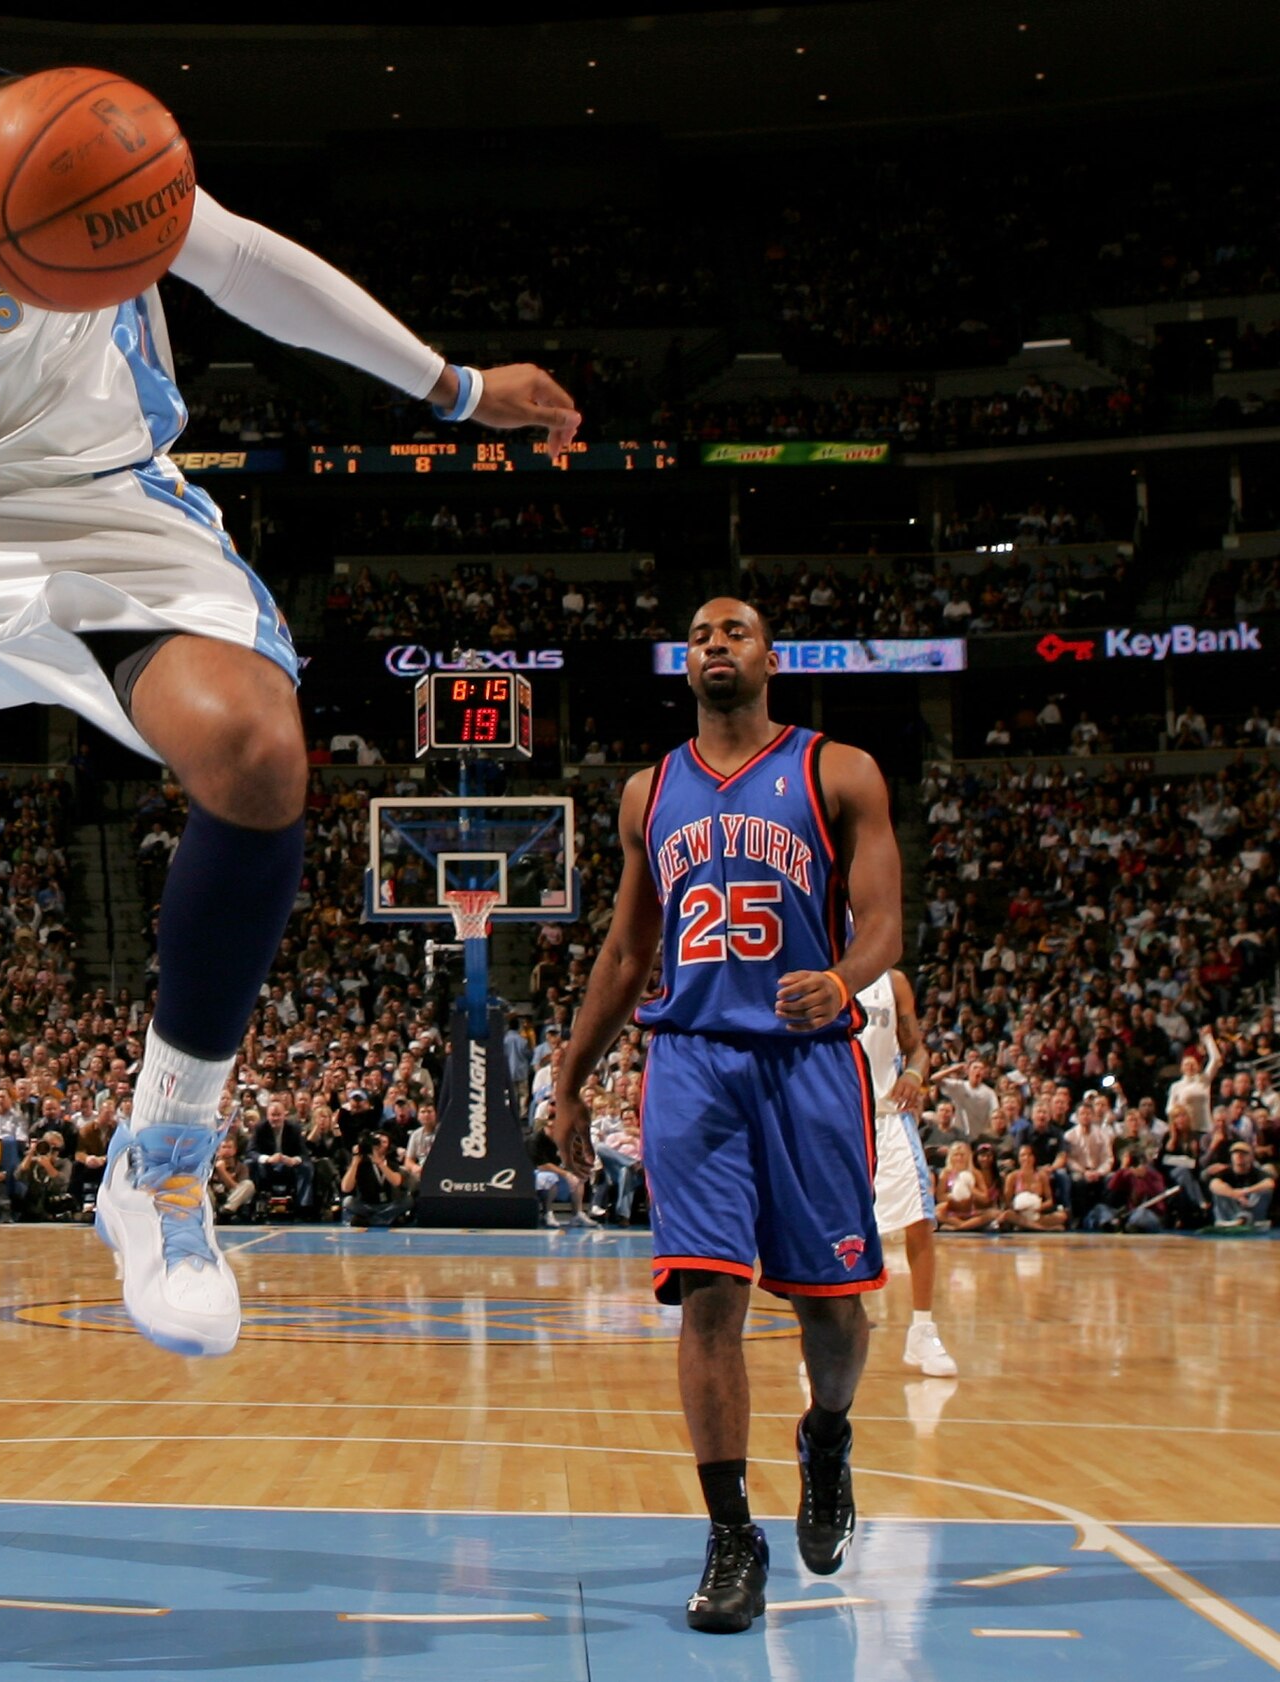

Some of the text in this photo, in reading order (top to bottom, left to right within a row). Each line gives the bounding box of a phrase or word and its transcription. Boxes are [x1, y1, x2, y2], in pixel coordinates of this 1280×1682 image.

[389, 443, 458, 456] NUGGETS
[475, 443, 505, 462] 8:15
[170, 451, 247, 470] PEPSI
[413, 456, 431, 474] 8
[1104, 620, 1262, 661] KeyBank
[451, 679, 508, 702] 8:15
[657, 813, 812, 897] NEW YORK
[676, 880, 784, 967] 25
[439, 1178, 487, 1193] Qwest
